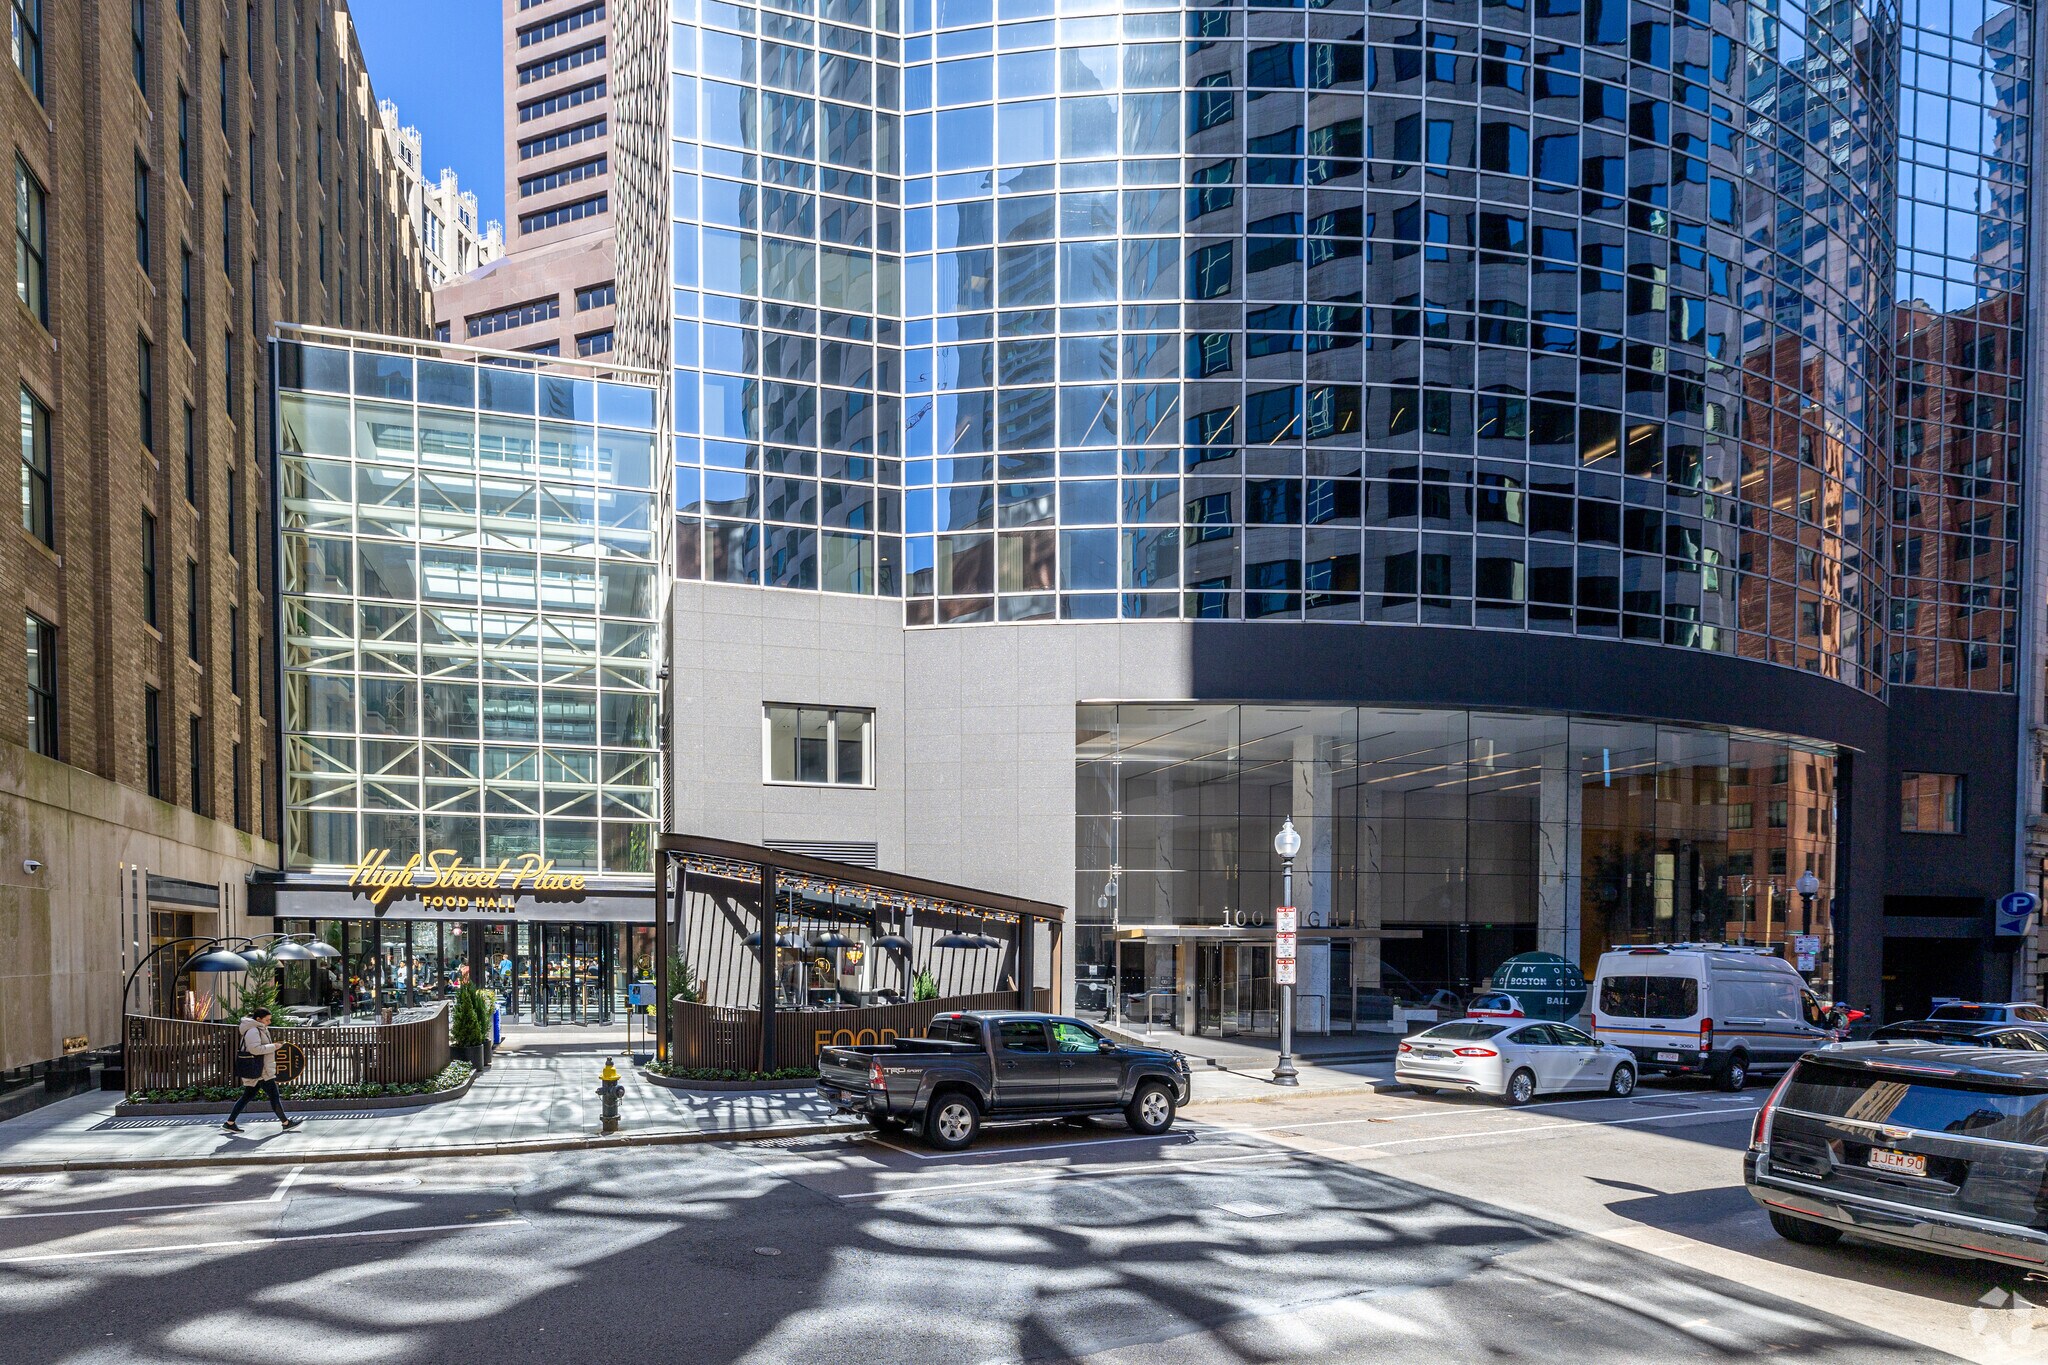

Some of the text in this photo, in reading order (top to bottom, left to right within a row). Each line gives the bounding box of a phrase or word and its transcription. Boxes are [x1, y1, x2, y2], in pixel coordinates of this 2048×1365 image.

[344, 848, 587, 905] High Street Place
[423, 896, 515, 909] FOOD HALL
[2012, 896, 2031, 912] P
[1222, 907, 1264, 928] 100
[1510, 977, 1547, 986] BOSTON
[1546, 996, 1570, 1005] BALL
[1872, 1152, 1904, 1166] 1JEM
[1907, 1158, 1923, 1170] 90
